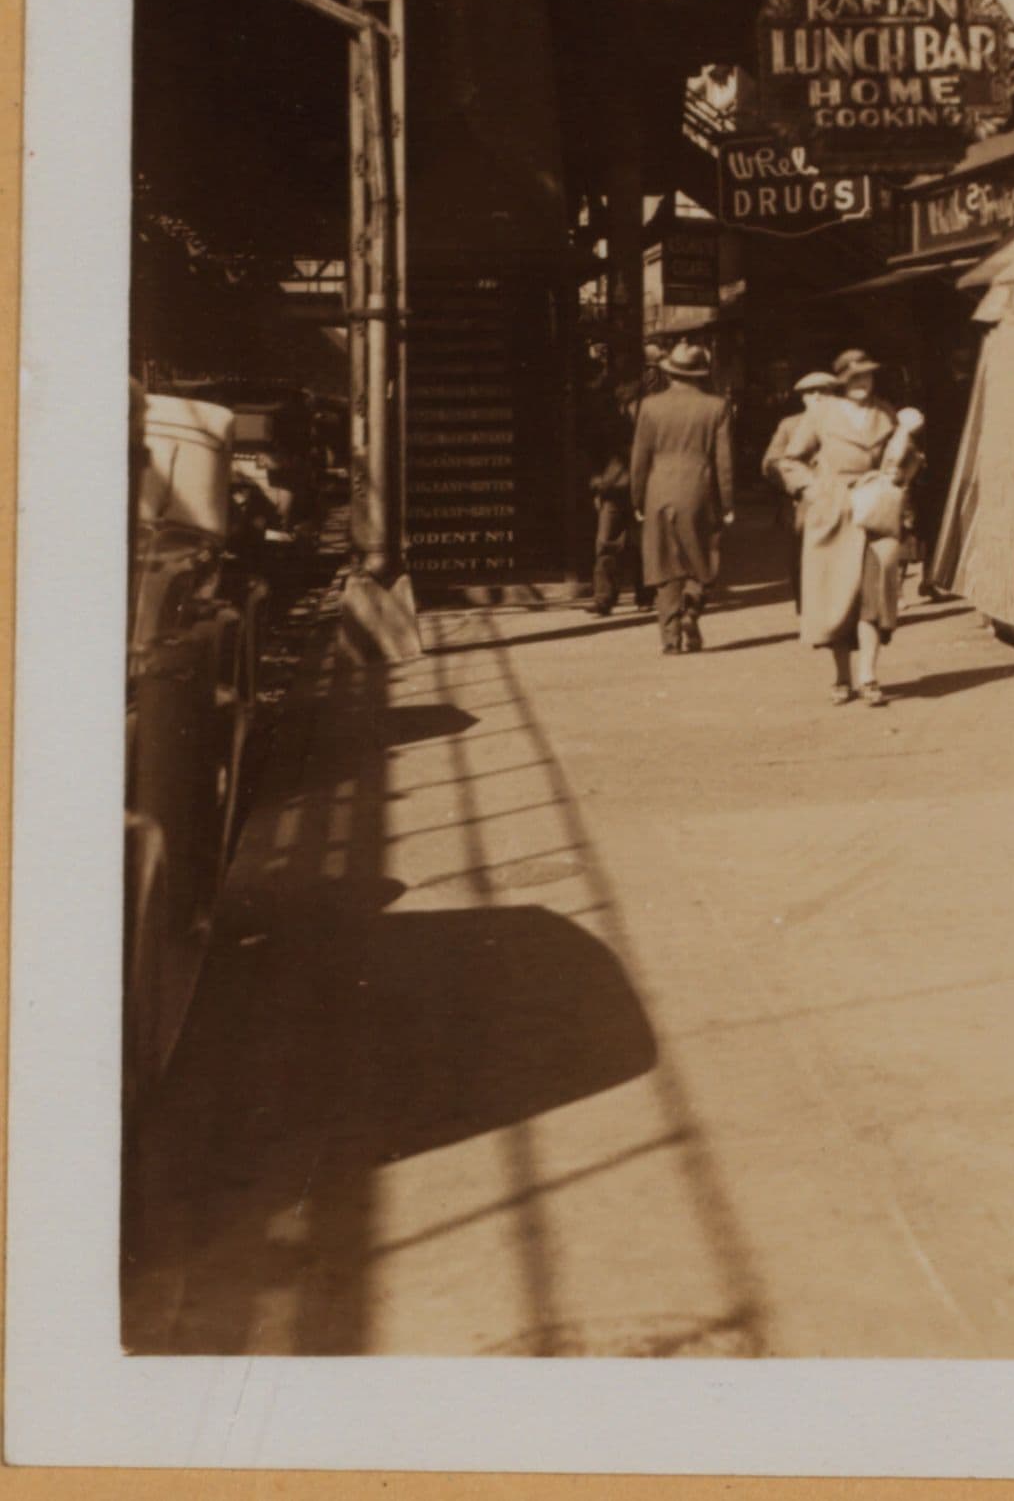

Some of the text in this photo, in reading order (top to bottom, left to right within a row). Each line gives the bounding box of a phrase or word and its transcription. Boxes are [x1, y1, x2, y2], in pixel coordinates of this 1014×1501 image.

[771, 21, 999, 76] LUNCH BAR
[808, 75, 962, 107] HOME
[814, 105, 963, 129] COOKING
[733, 179, 856, 218] DRUGS
